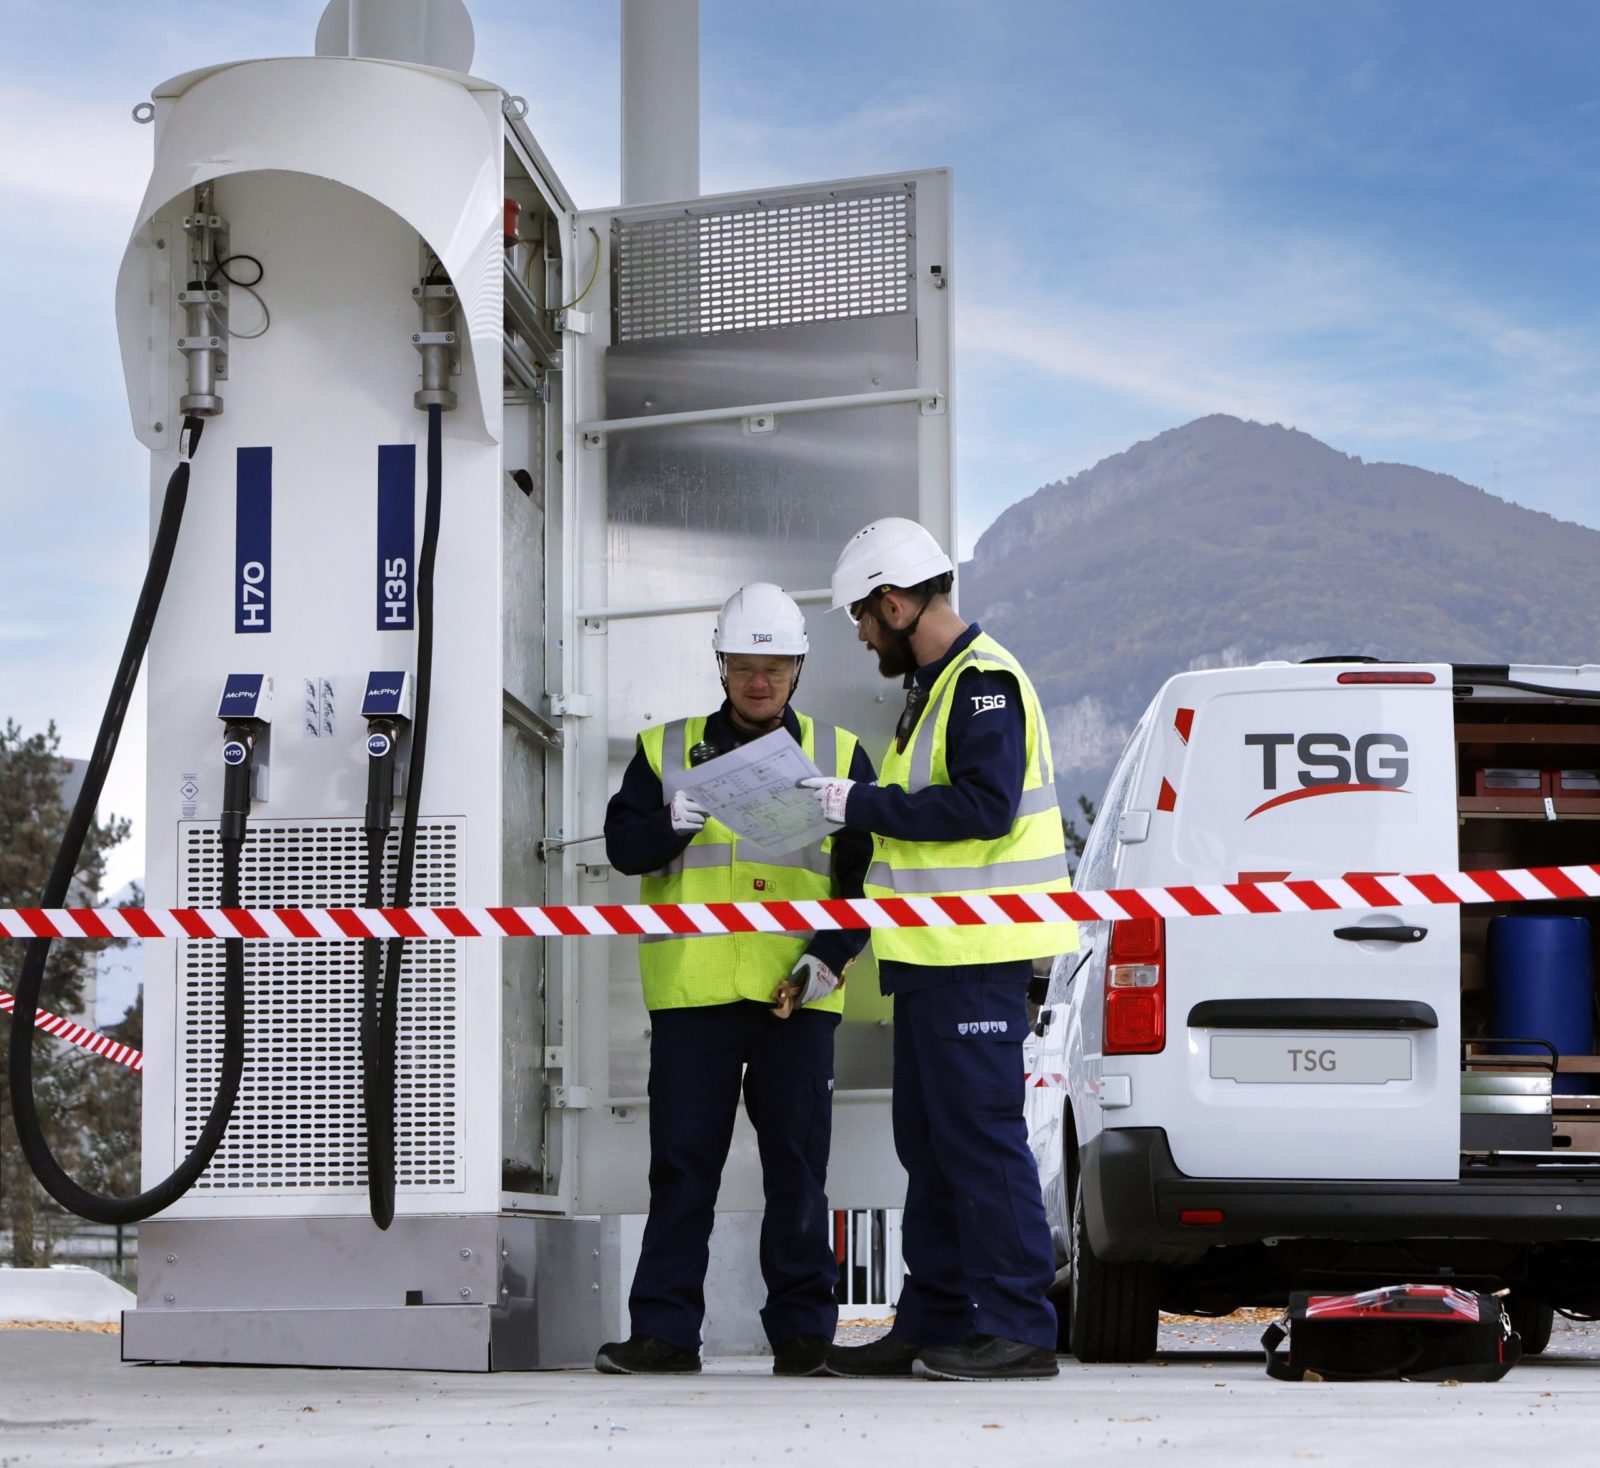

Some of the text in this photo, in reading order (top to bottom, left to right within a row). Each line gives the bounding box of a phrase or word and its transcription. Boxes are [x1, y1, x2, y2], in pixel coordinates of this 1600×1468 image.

[243, 561, 265, 626] H70
[385, 557, 407, 623] H35
[752, 633, 772, 642] TSG
[225, 691, 256, 699] McPhy
[368, 688, 399, 696] McPhy
[971, 694, 1006, 710] TSG
[225, 749, 241, 757] H70
[1244, 733, 1409, 790] TSG
[1287, 1049, 1336, 1071] TSG
